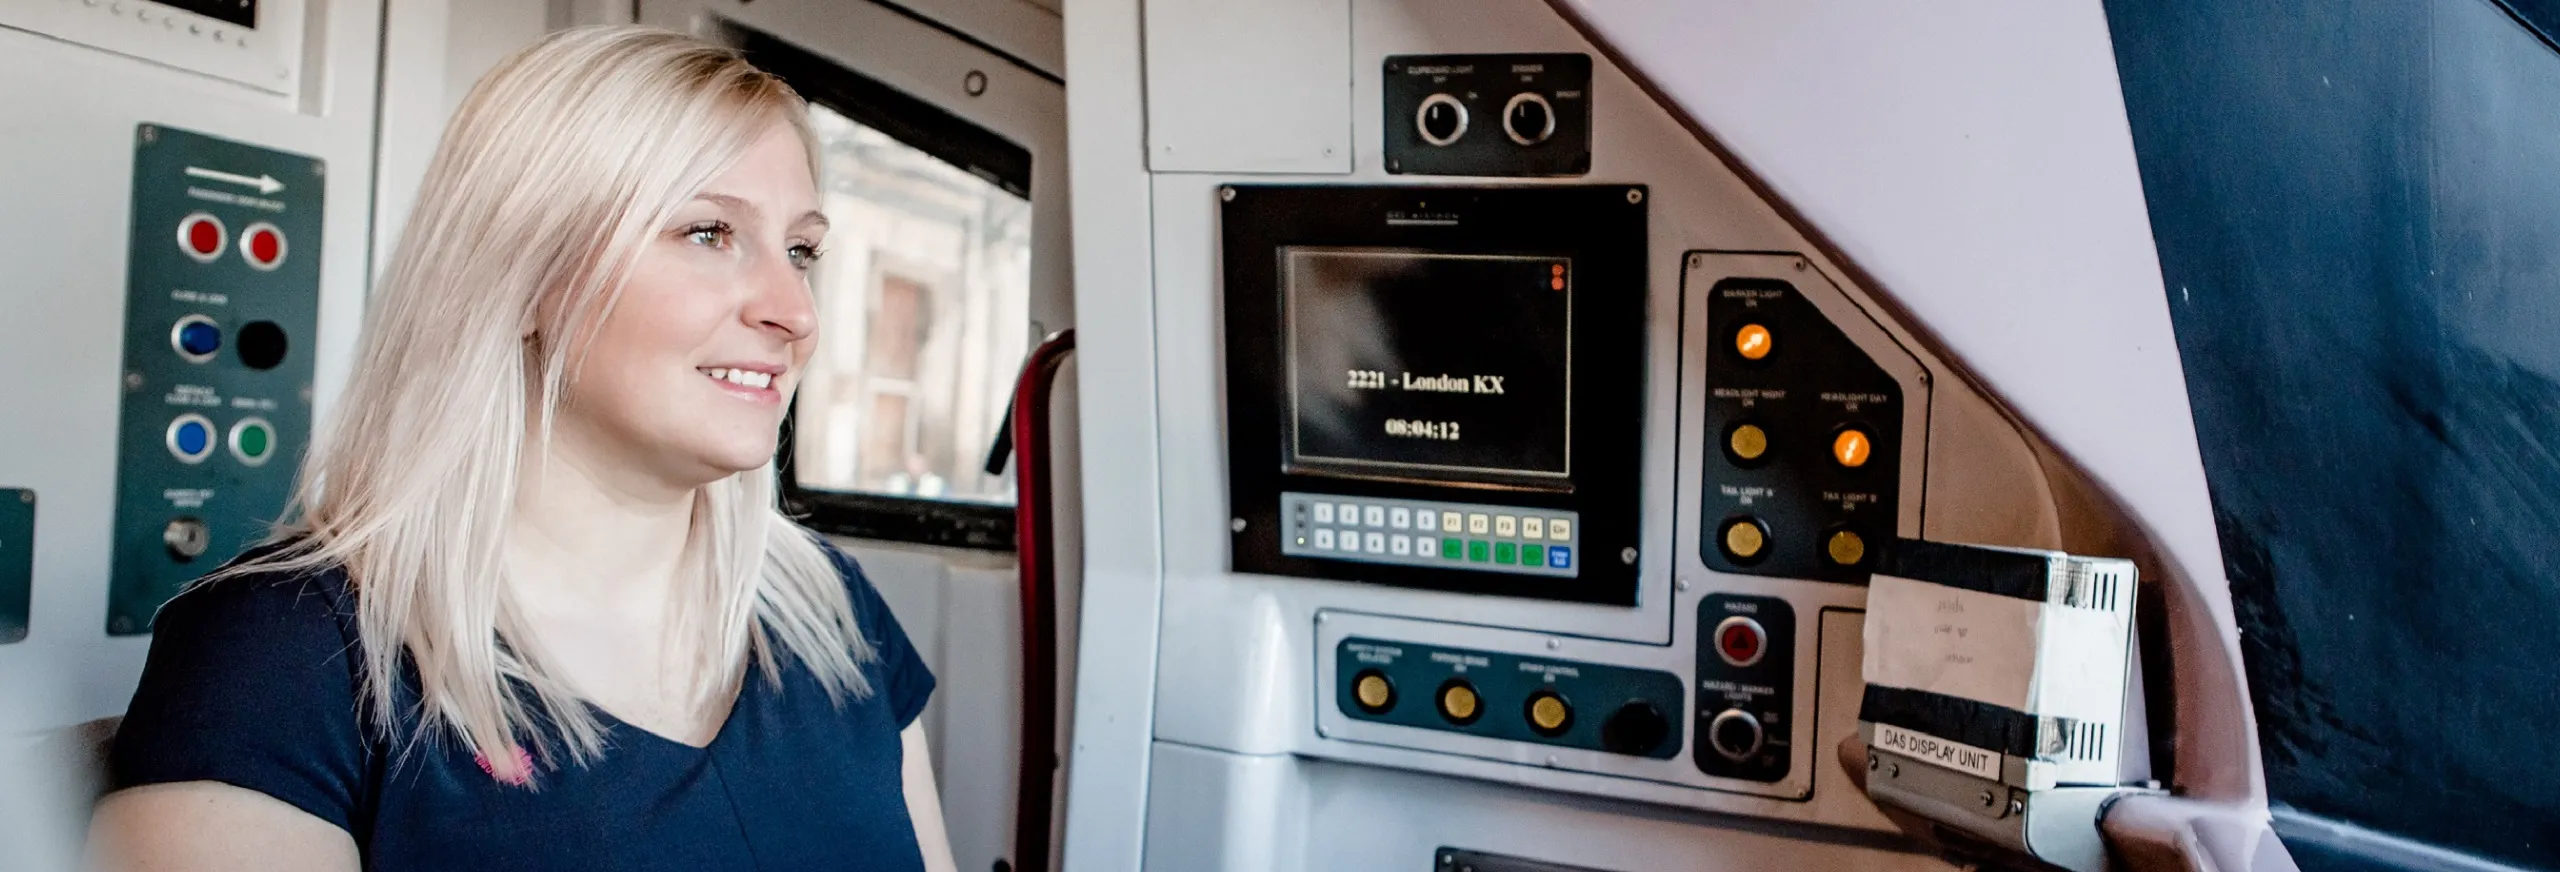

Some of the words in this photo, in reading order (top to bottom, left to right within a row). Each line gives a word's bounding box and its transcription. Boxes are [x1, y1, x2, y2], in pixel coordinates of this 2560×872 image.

[1347, 370, 1385, 390] 2221
[1403, 371, 1469, 394] London
[1474, 374, 1505, 394] KX
[1869, 393, 1888, 403] DAY
[1385, 418, 1460, 440] 08:04:12
[1740, 487, 1764, 497] LIGHT
[1842, 492, 1867, 502] LIGHT
[1884, 729, 1906, 748] DAS
[1909, 735, 1955, 762] DISPLAY
[1959, 748, 1989, 771] UNIT
